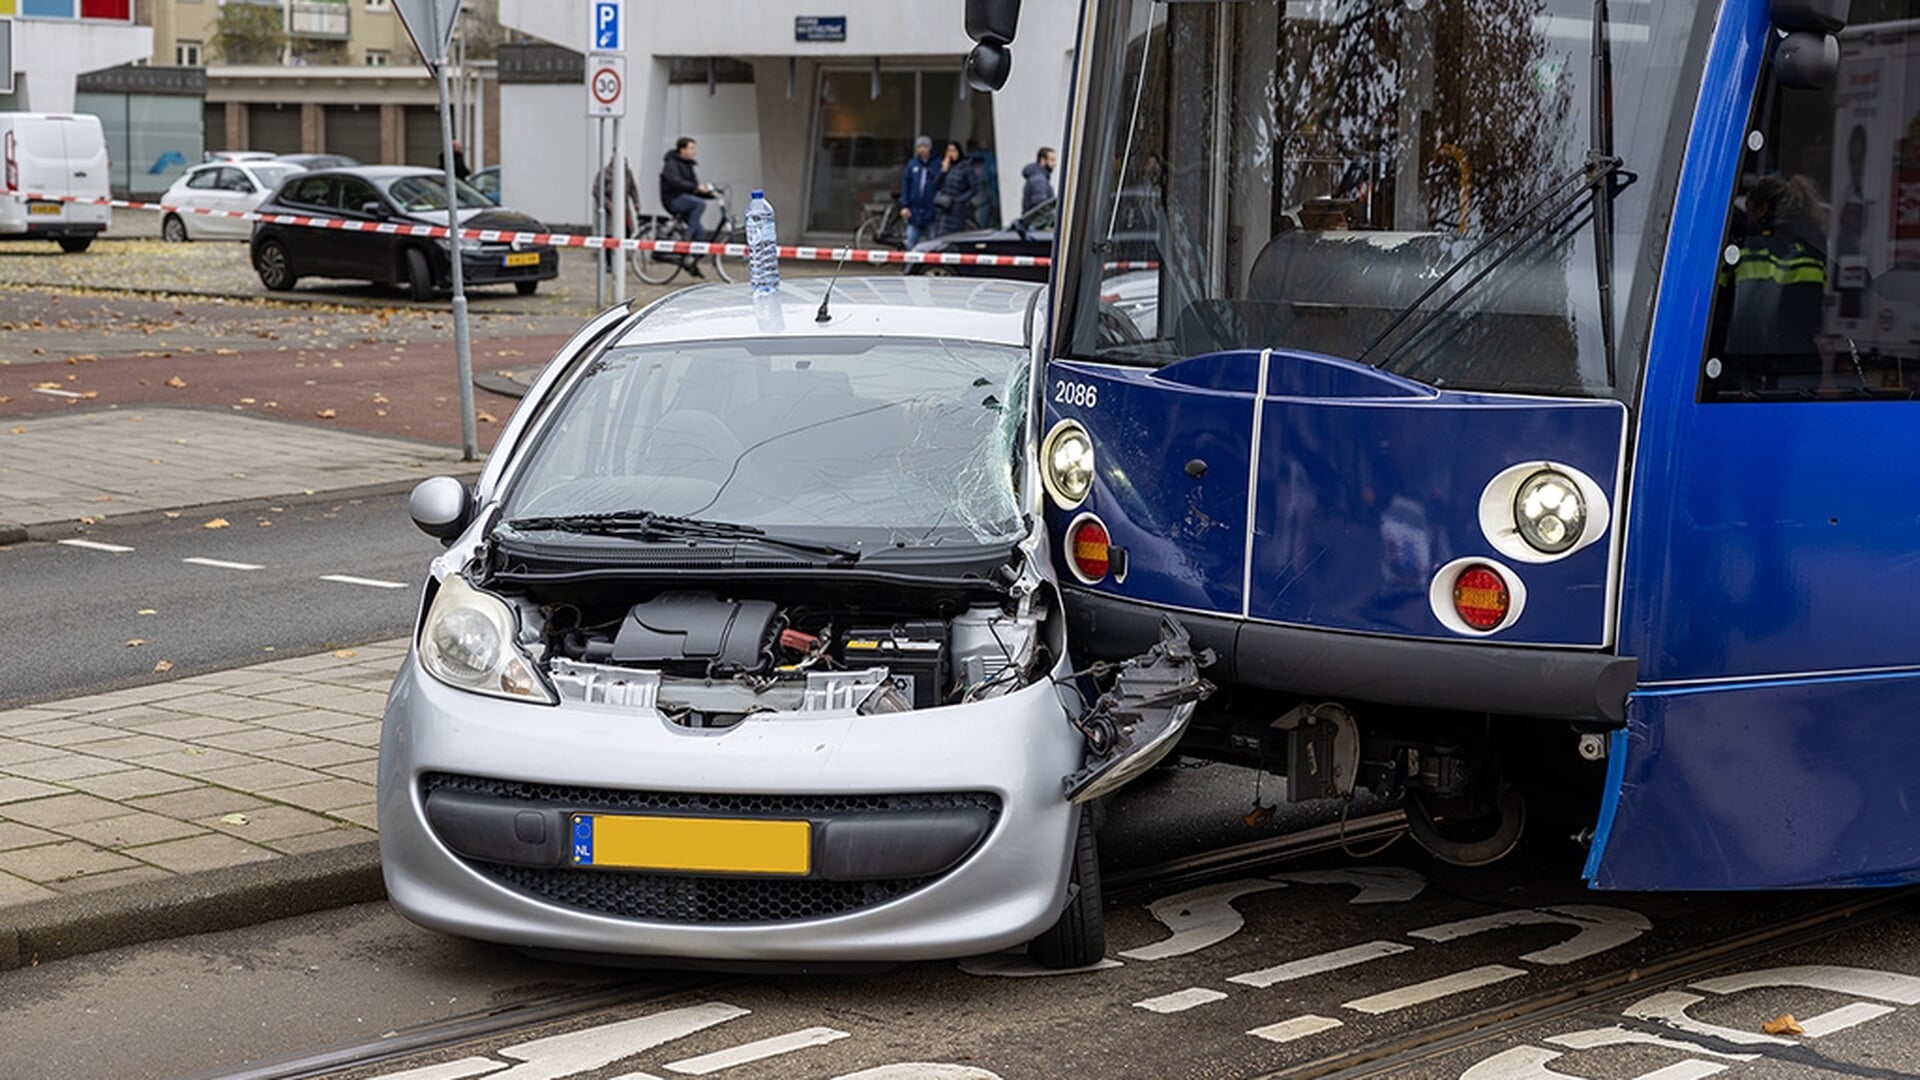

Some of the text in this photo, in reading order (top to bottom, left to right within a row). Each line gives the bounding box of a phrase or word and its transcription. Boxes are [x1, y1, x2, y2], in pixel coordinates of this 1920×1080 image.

[600, 6, 615, 30] P
[598, 78, 616, 93] 30
[1054, 380, 1098, 408] 2086
[575, 845, 590, 857] NL
